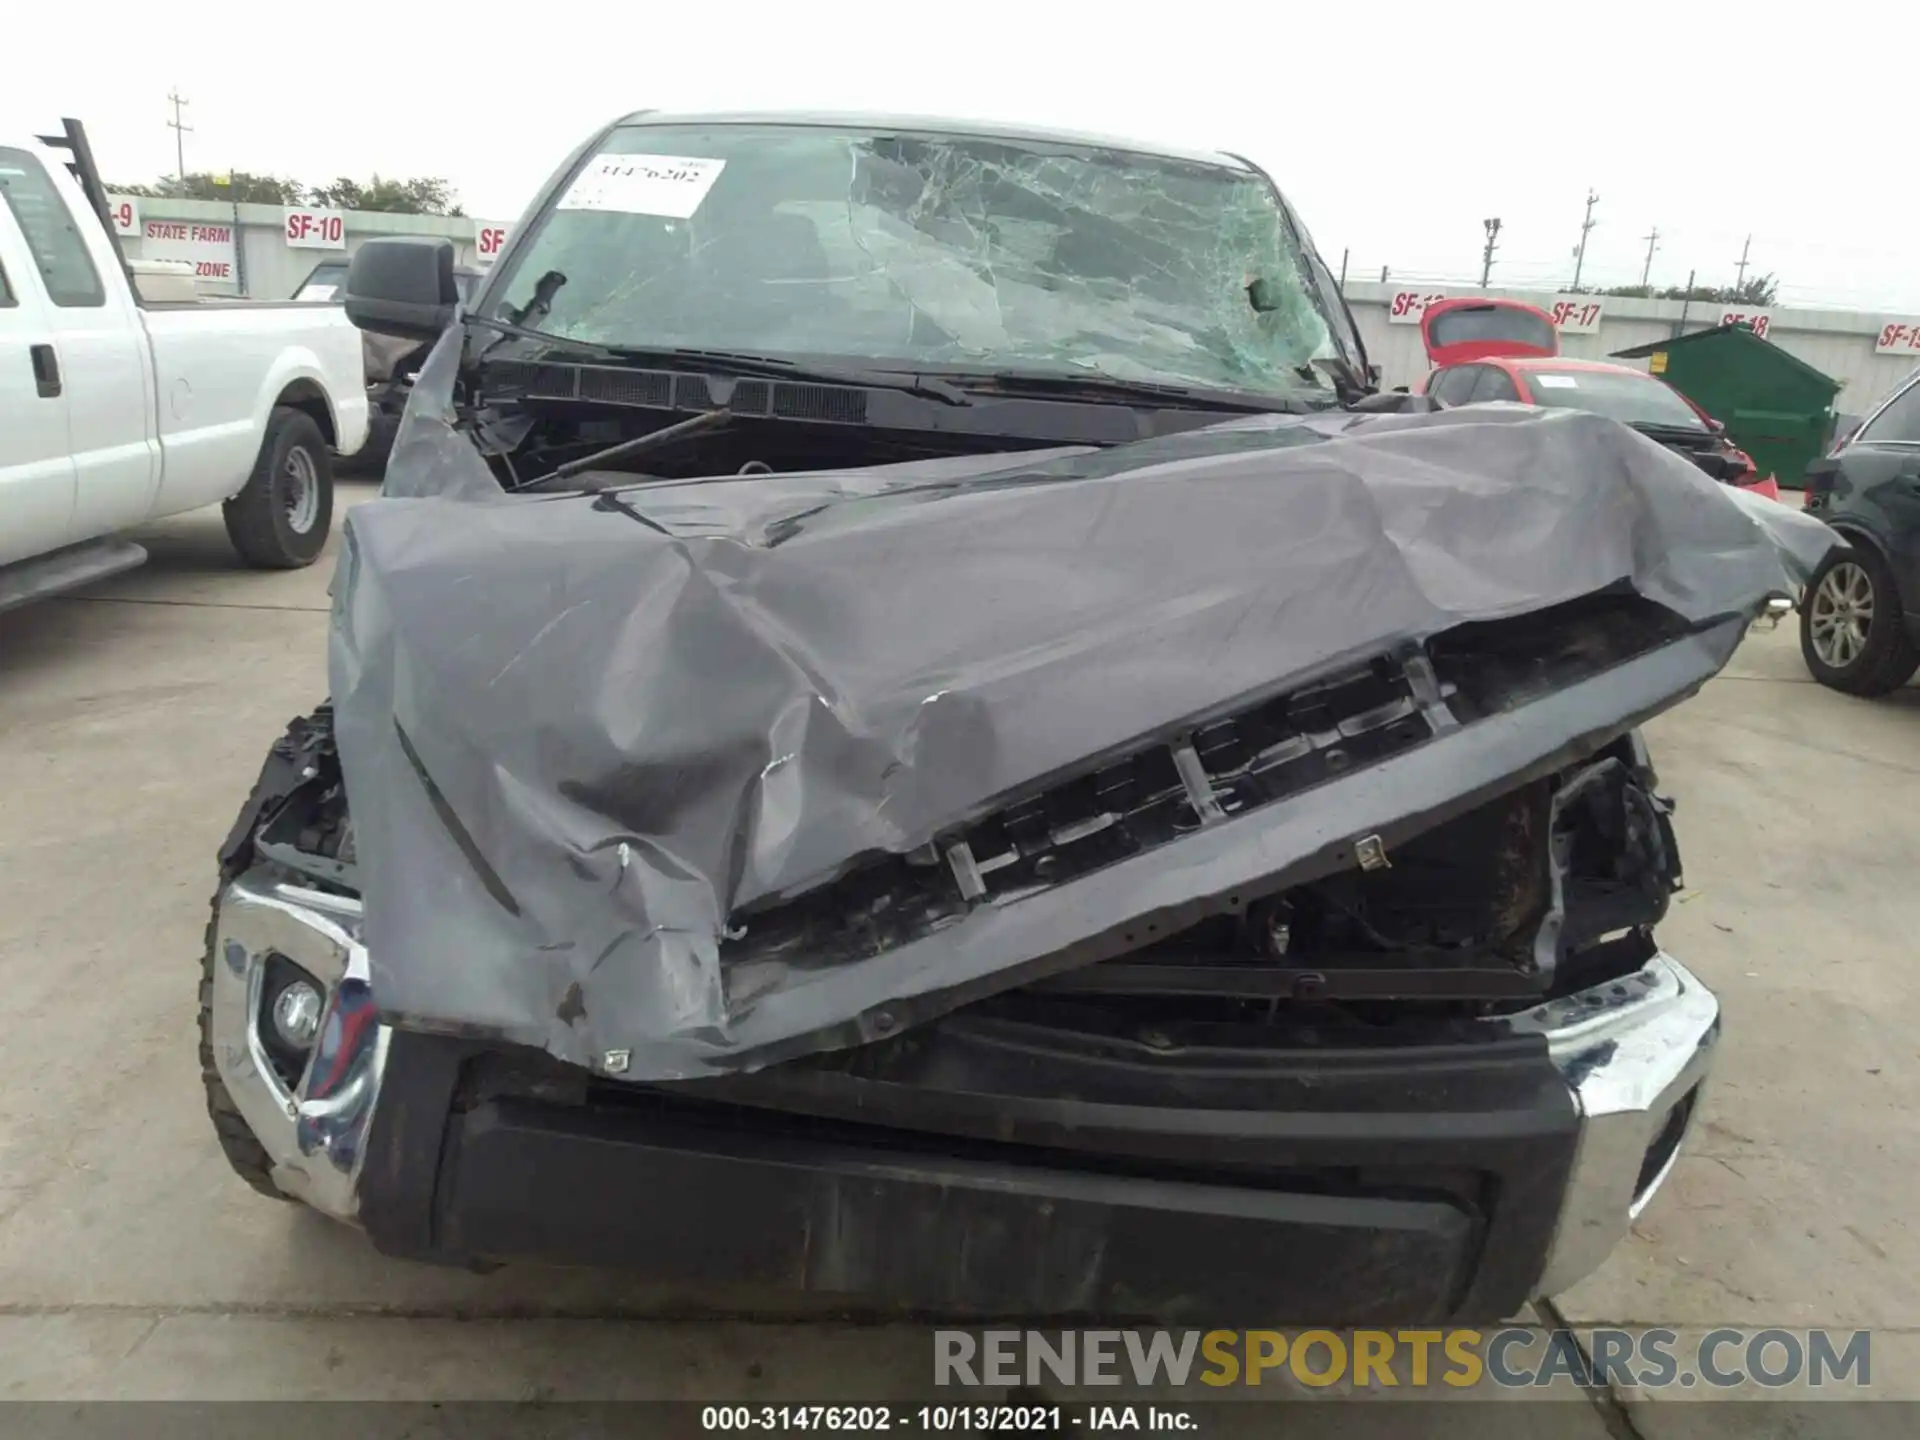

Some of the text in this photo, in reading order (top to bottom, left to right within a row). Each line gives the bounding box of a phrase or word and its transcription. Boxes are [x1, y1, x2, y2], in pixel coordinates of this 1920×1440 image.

[147, 223, 231, 243] STATE FARM
[287, 214, 342, 242] SF-10
[195, 260, 231, 278] ZONE
[1391, 292, 1445, 316] SF-
[1552, 302, 1601, 327] SF-17
